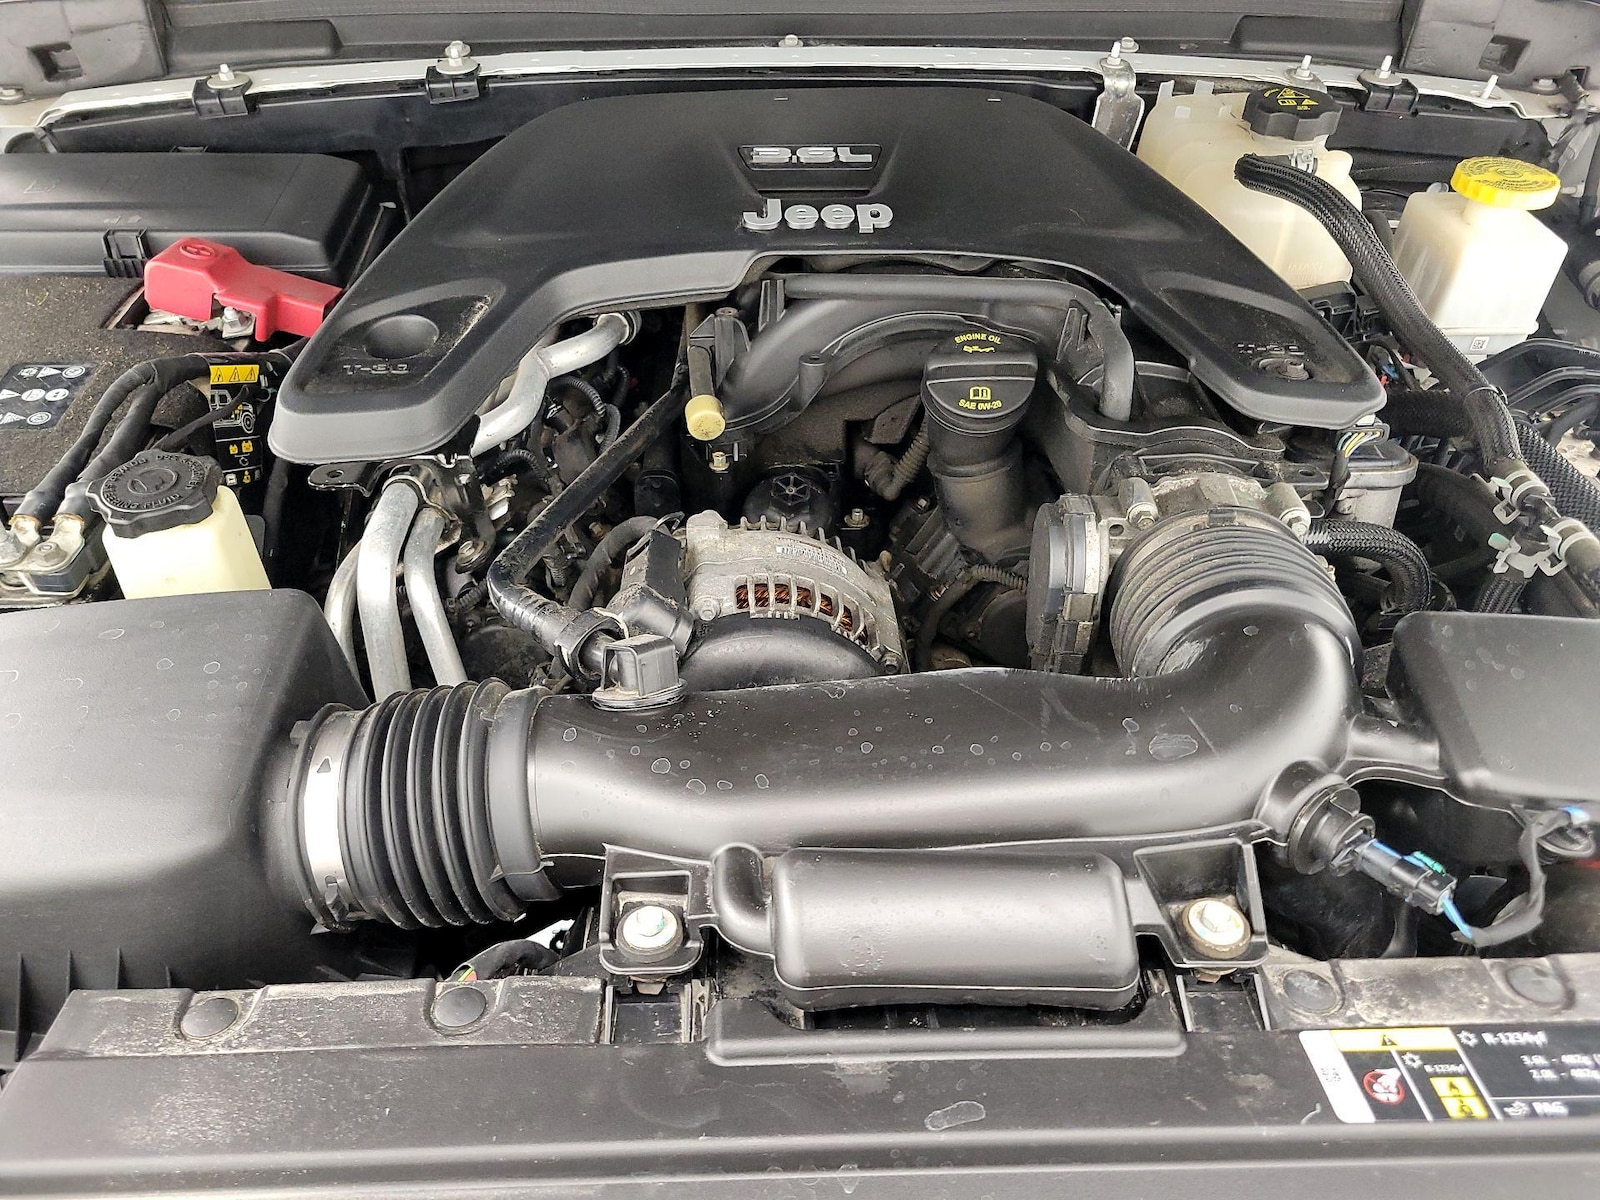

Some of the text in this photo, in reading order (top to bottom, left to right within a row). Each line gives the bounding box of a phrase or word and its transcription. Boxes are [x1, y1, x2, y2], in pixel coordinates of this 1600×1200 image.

[751, 146, 873, 164] 3.6L
[742, 198, 894, 234] Jeep
[954, 333, 1002, 345] ENGINE OIL
[958, 398, 1003, 411] SAE 0W-20
[1481, 1030, 1548, 1048] R-1234yf
